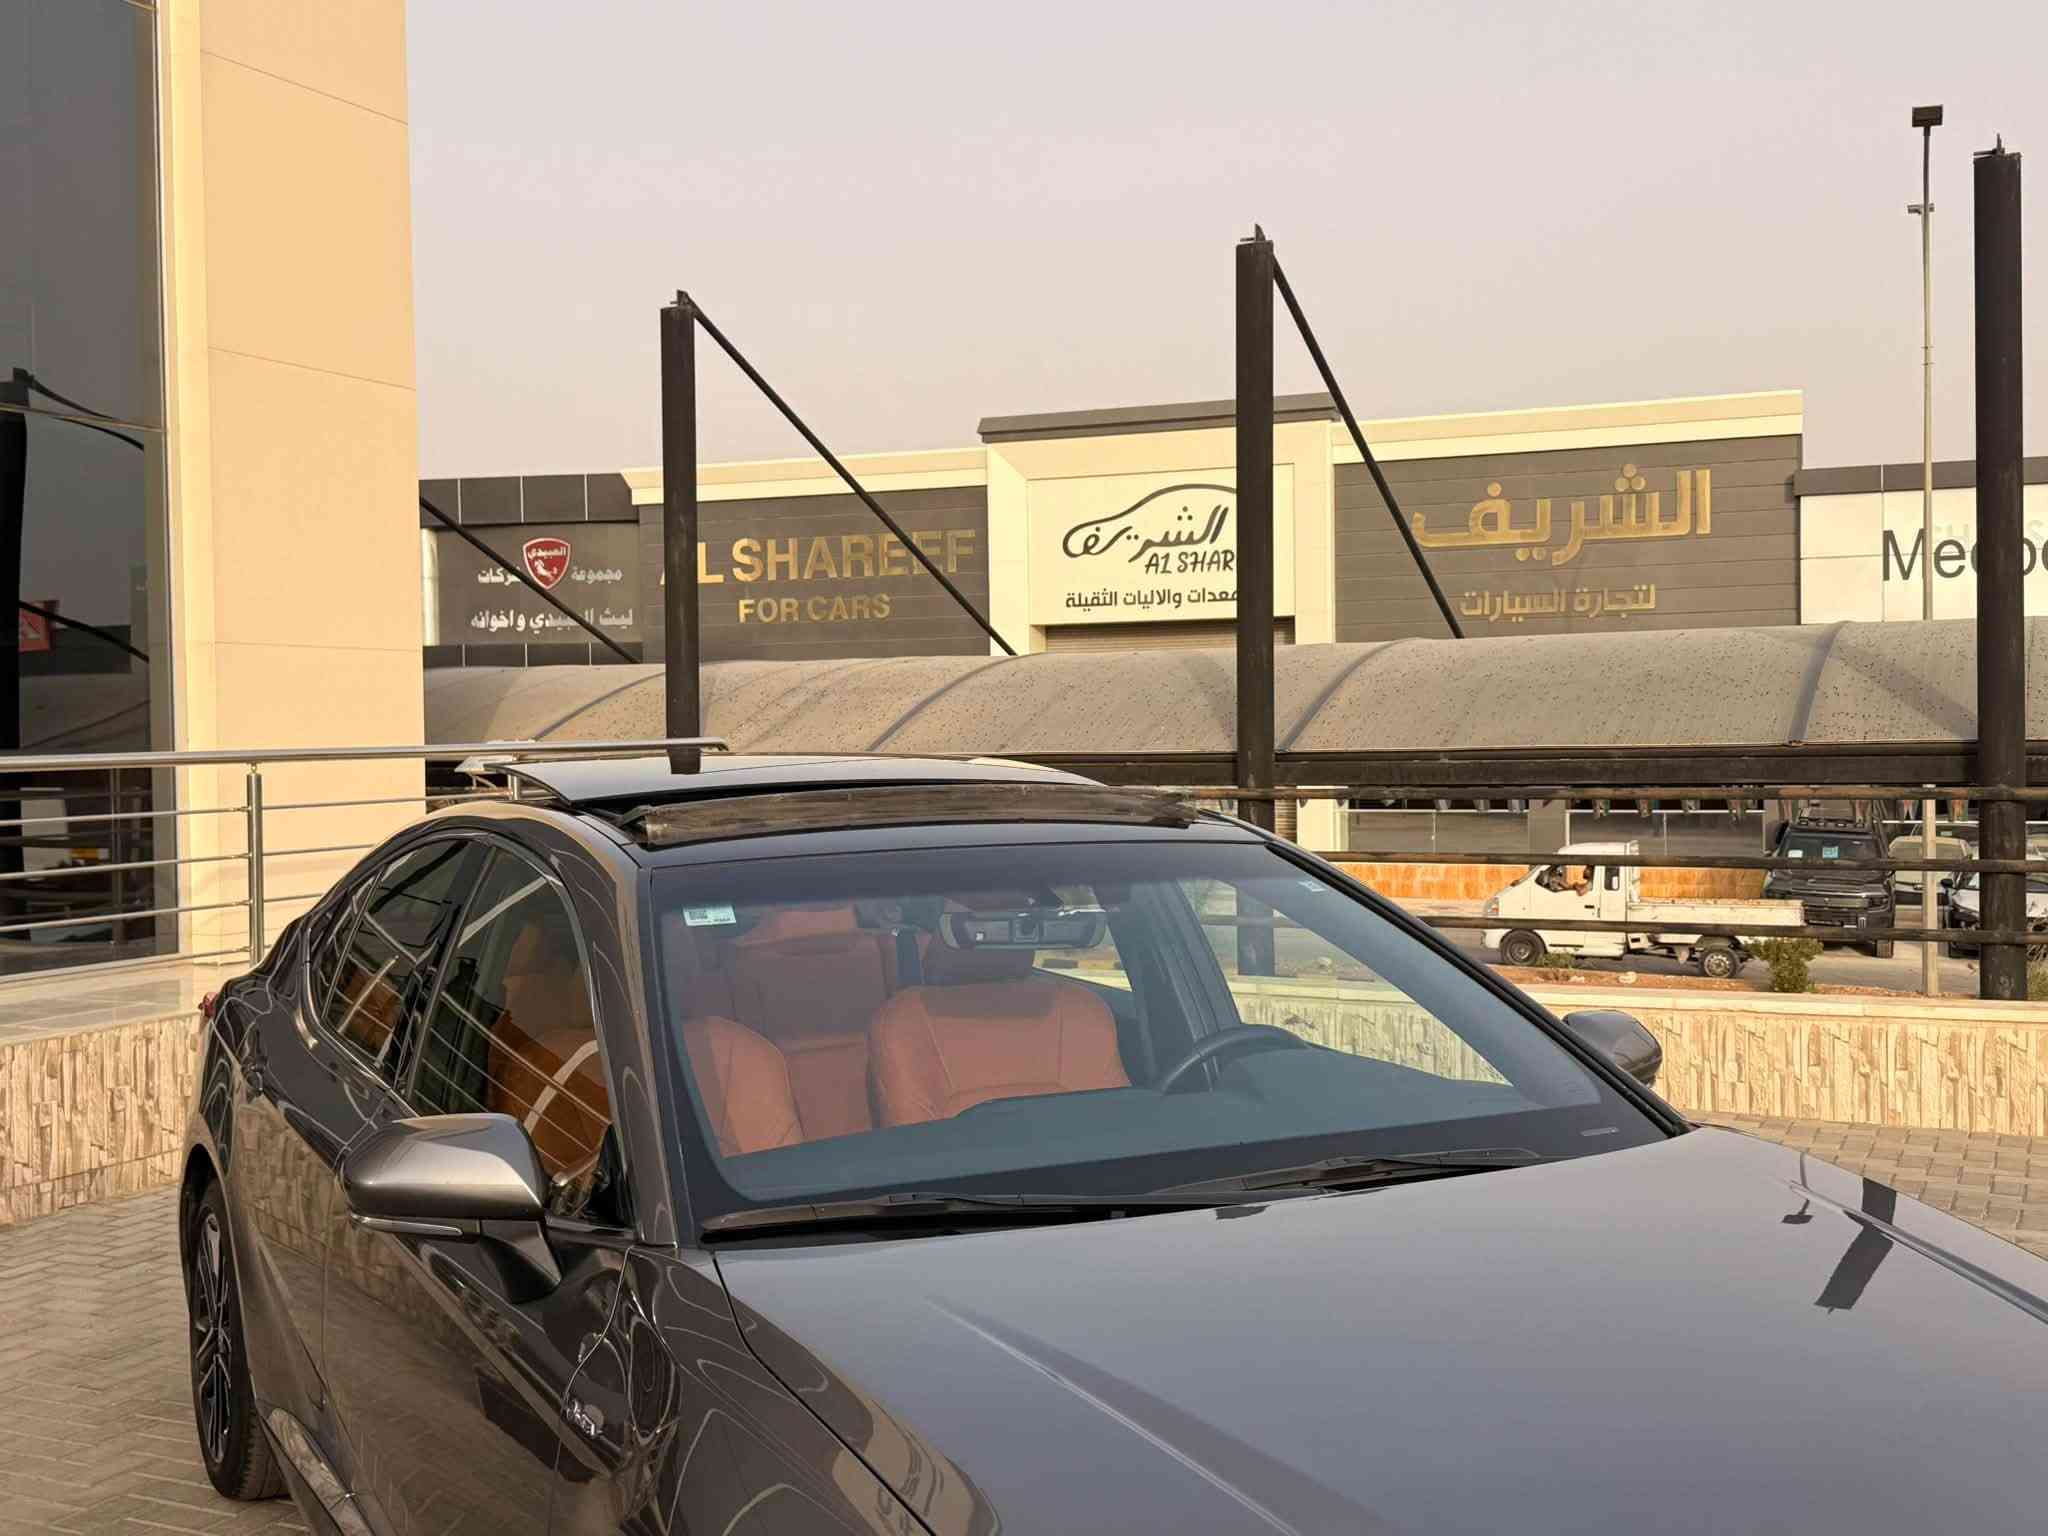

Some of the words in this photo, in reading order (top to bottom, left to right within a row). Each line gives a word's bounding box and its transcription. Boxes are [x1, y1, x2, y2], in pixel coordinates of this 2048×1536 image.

[1412, 463, 1711, 566] الشريف
[1062, 502, 1230, 563] الشريف
[659, 541, 725, 586] L
[732, 529, 977, 583] SHAREEF
[1177, 549, 1236, 574] SHAR
[571, 565, 624, 585] مجموعة
[738, 598, 800, 624] FOR
[806, 593, 892, 621] CARS
[1065, 587, 1119, 613] الثقيلة
[1122, 589, 1183, 610] والاليات
[1459, 588, 1567, 623] السيارات
[1573, 584, 1656, 619] لتجارة
[599, 607, 634, 630] ليث
